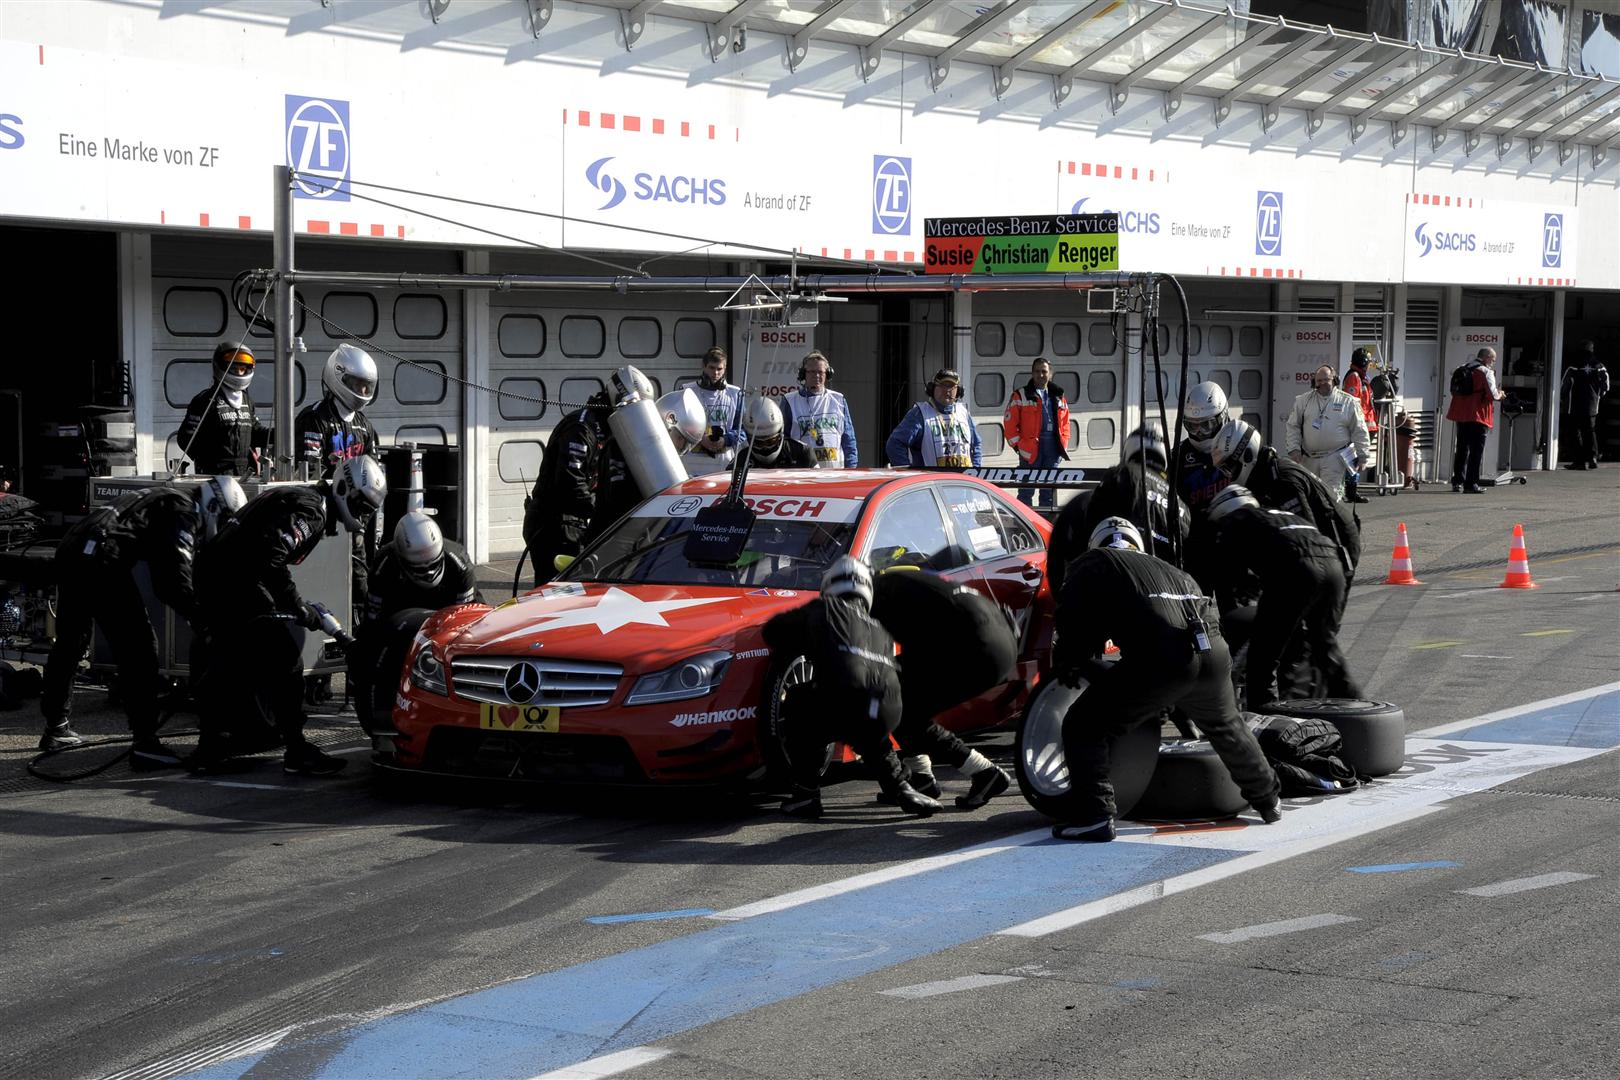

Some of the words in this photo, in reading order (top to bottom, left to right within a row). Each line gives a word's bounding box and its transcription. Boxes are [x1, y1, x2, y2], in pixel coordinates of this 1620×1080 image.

[59, 133, 97, 157] Eine
[104, 138, 158, 163] Marke
[164, 148, 193, 166] von
[199, 146, 219, 168] ZF
[633, 172, 727, 206] SACHS
[743, 192, 752, 208] A
[755, 192, 784, 210] brand
[787, 195, 797, 210] of
[799, 195, 812, 211] ZF
[926, 217, 1050, 237] Mercedes-Benz
[1055, 215, 1117, 234] Service
[1103, 210, 1160, 234] ACHS
[1171, 222, 1186, 237] Eine
[1188, 224, 1207, 238] Marke
[1209, 228, 1221, 239] von
[1222, 226, 1231, 239] ZF
[1435, 232, 1476, 252] SACHS
[1488, 242, 1502, 253] brand
[927, 244, 974, 266] Susie
[982, 243, 1049, 265] Christian
[1058, 241, 1117, 268] Renger
[761, 332, 806, 343] BOSCH
[1296, 331, 1331, 341] BOSCH
[1466, 334, 1498, 343] BOSCH
[815, 449, 838, 462] DAC
[97, 487, 122, 497] TEAM
[692, 523, 748, 535] Mercedes-Benz
[701, 533, 730, 543] Service
